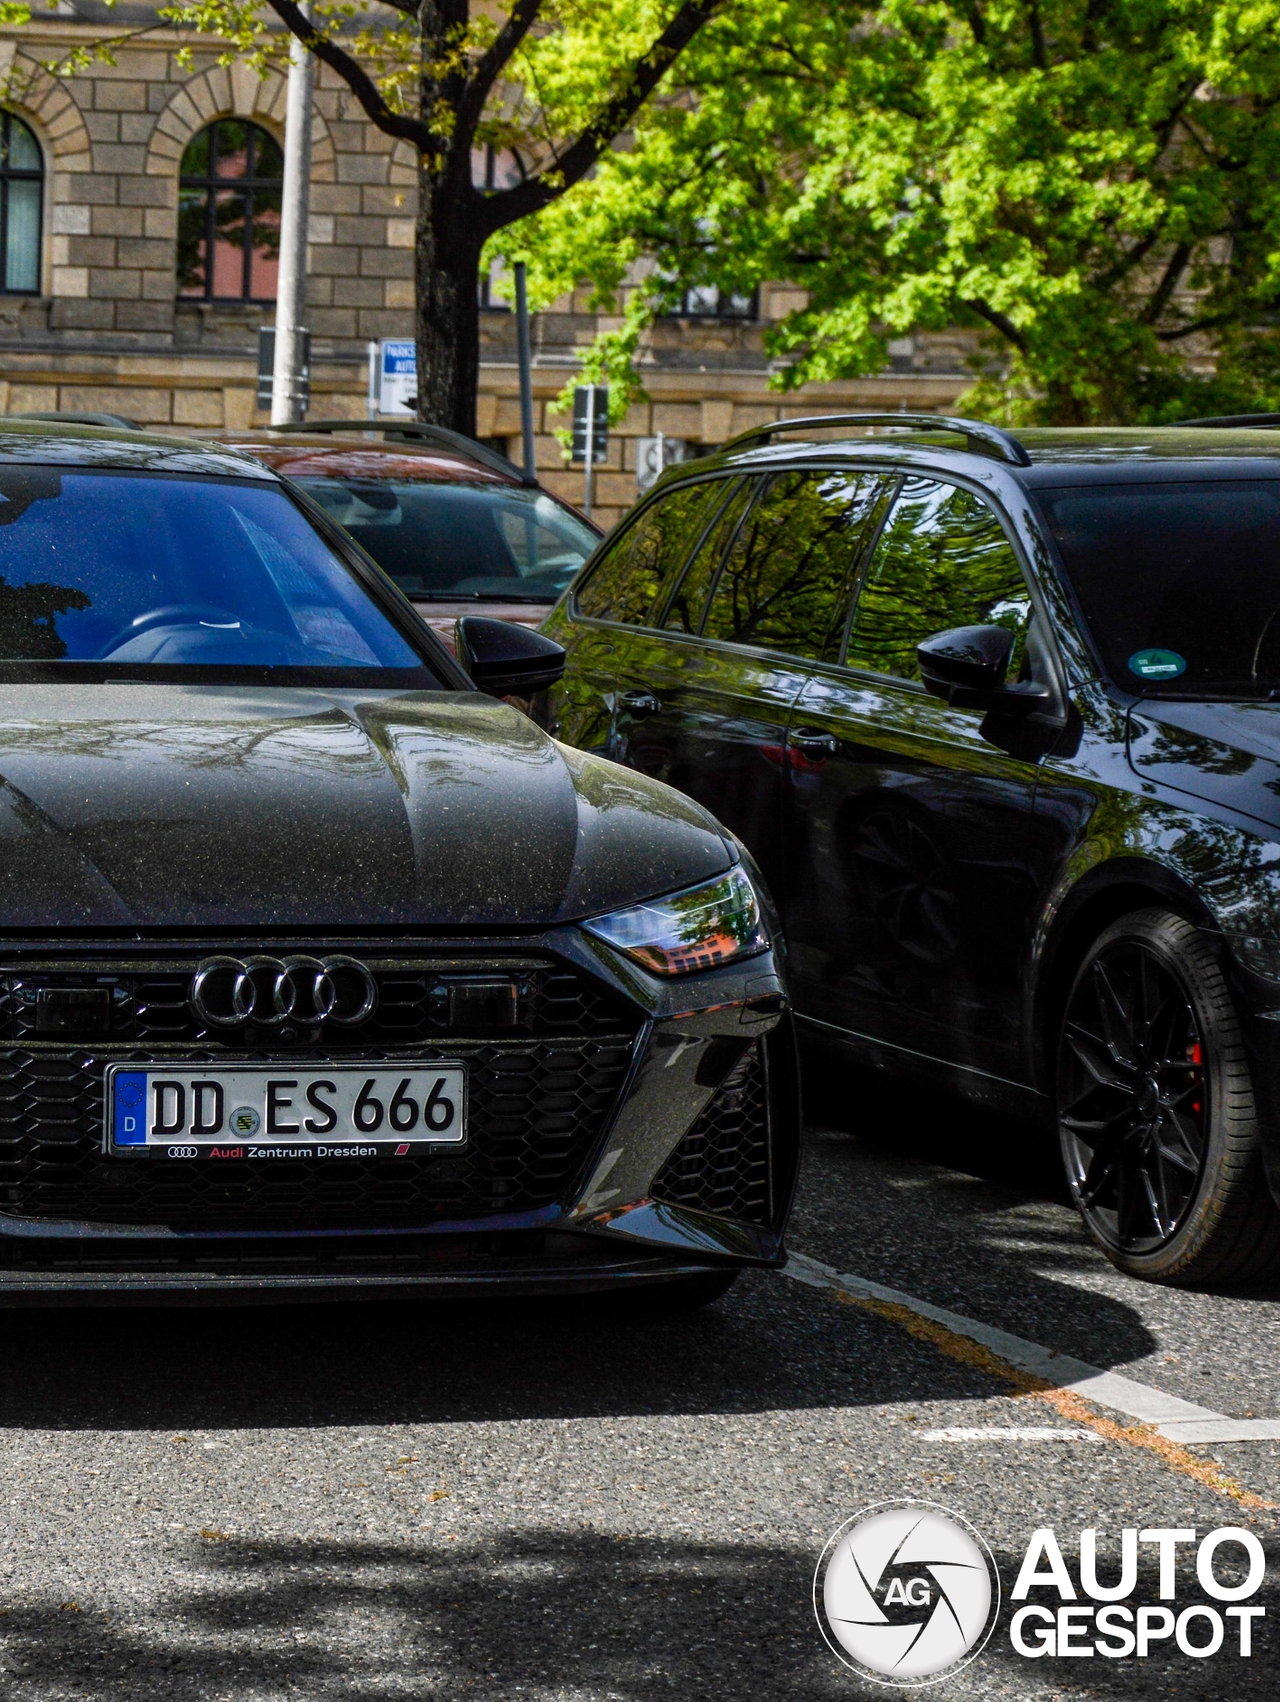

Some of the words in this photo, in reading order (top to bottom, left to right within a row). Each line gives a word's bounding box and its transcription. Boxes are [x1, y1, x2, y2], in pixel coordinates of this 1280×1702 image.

[1151, 653, 1162, 664] 4
[124, 1116, 136, 1132] D
[150, 1080, 224, 1135] DD
[266, 1080, 338, 1134] ES
[352, 1078, 455, 1132] 666
[209, 1147, 244, 1158] Audi
[248, 1146, 313, 1158] Zentrum
[317, 1145, 377, 1157] Dresden
